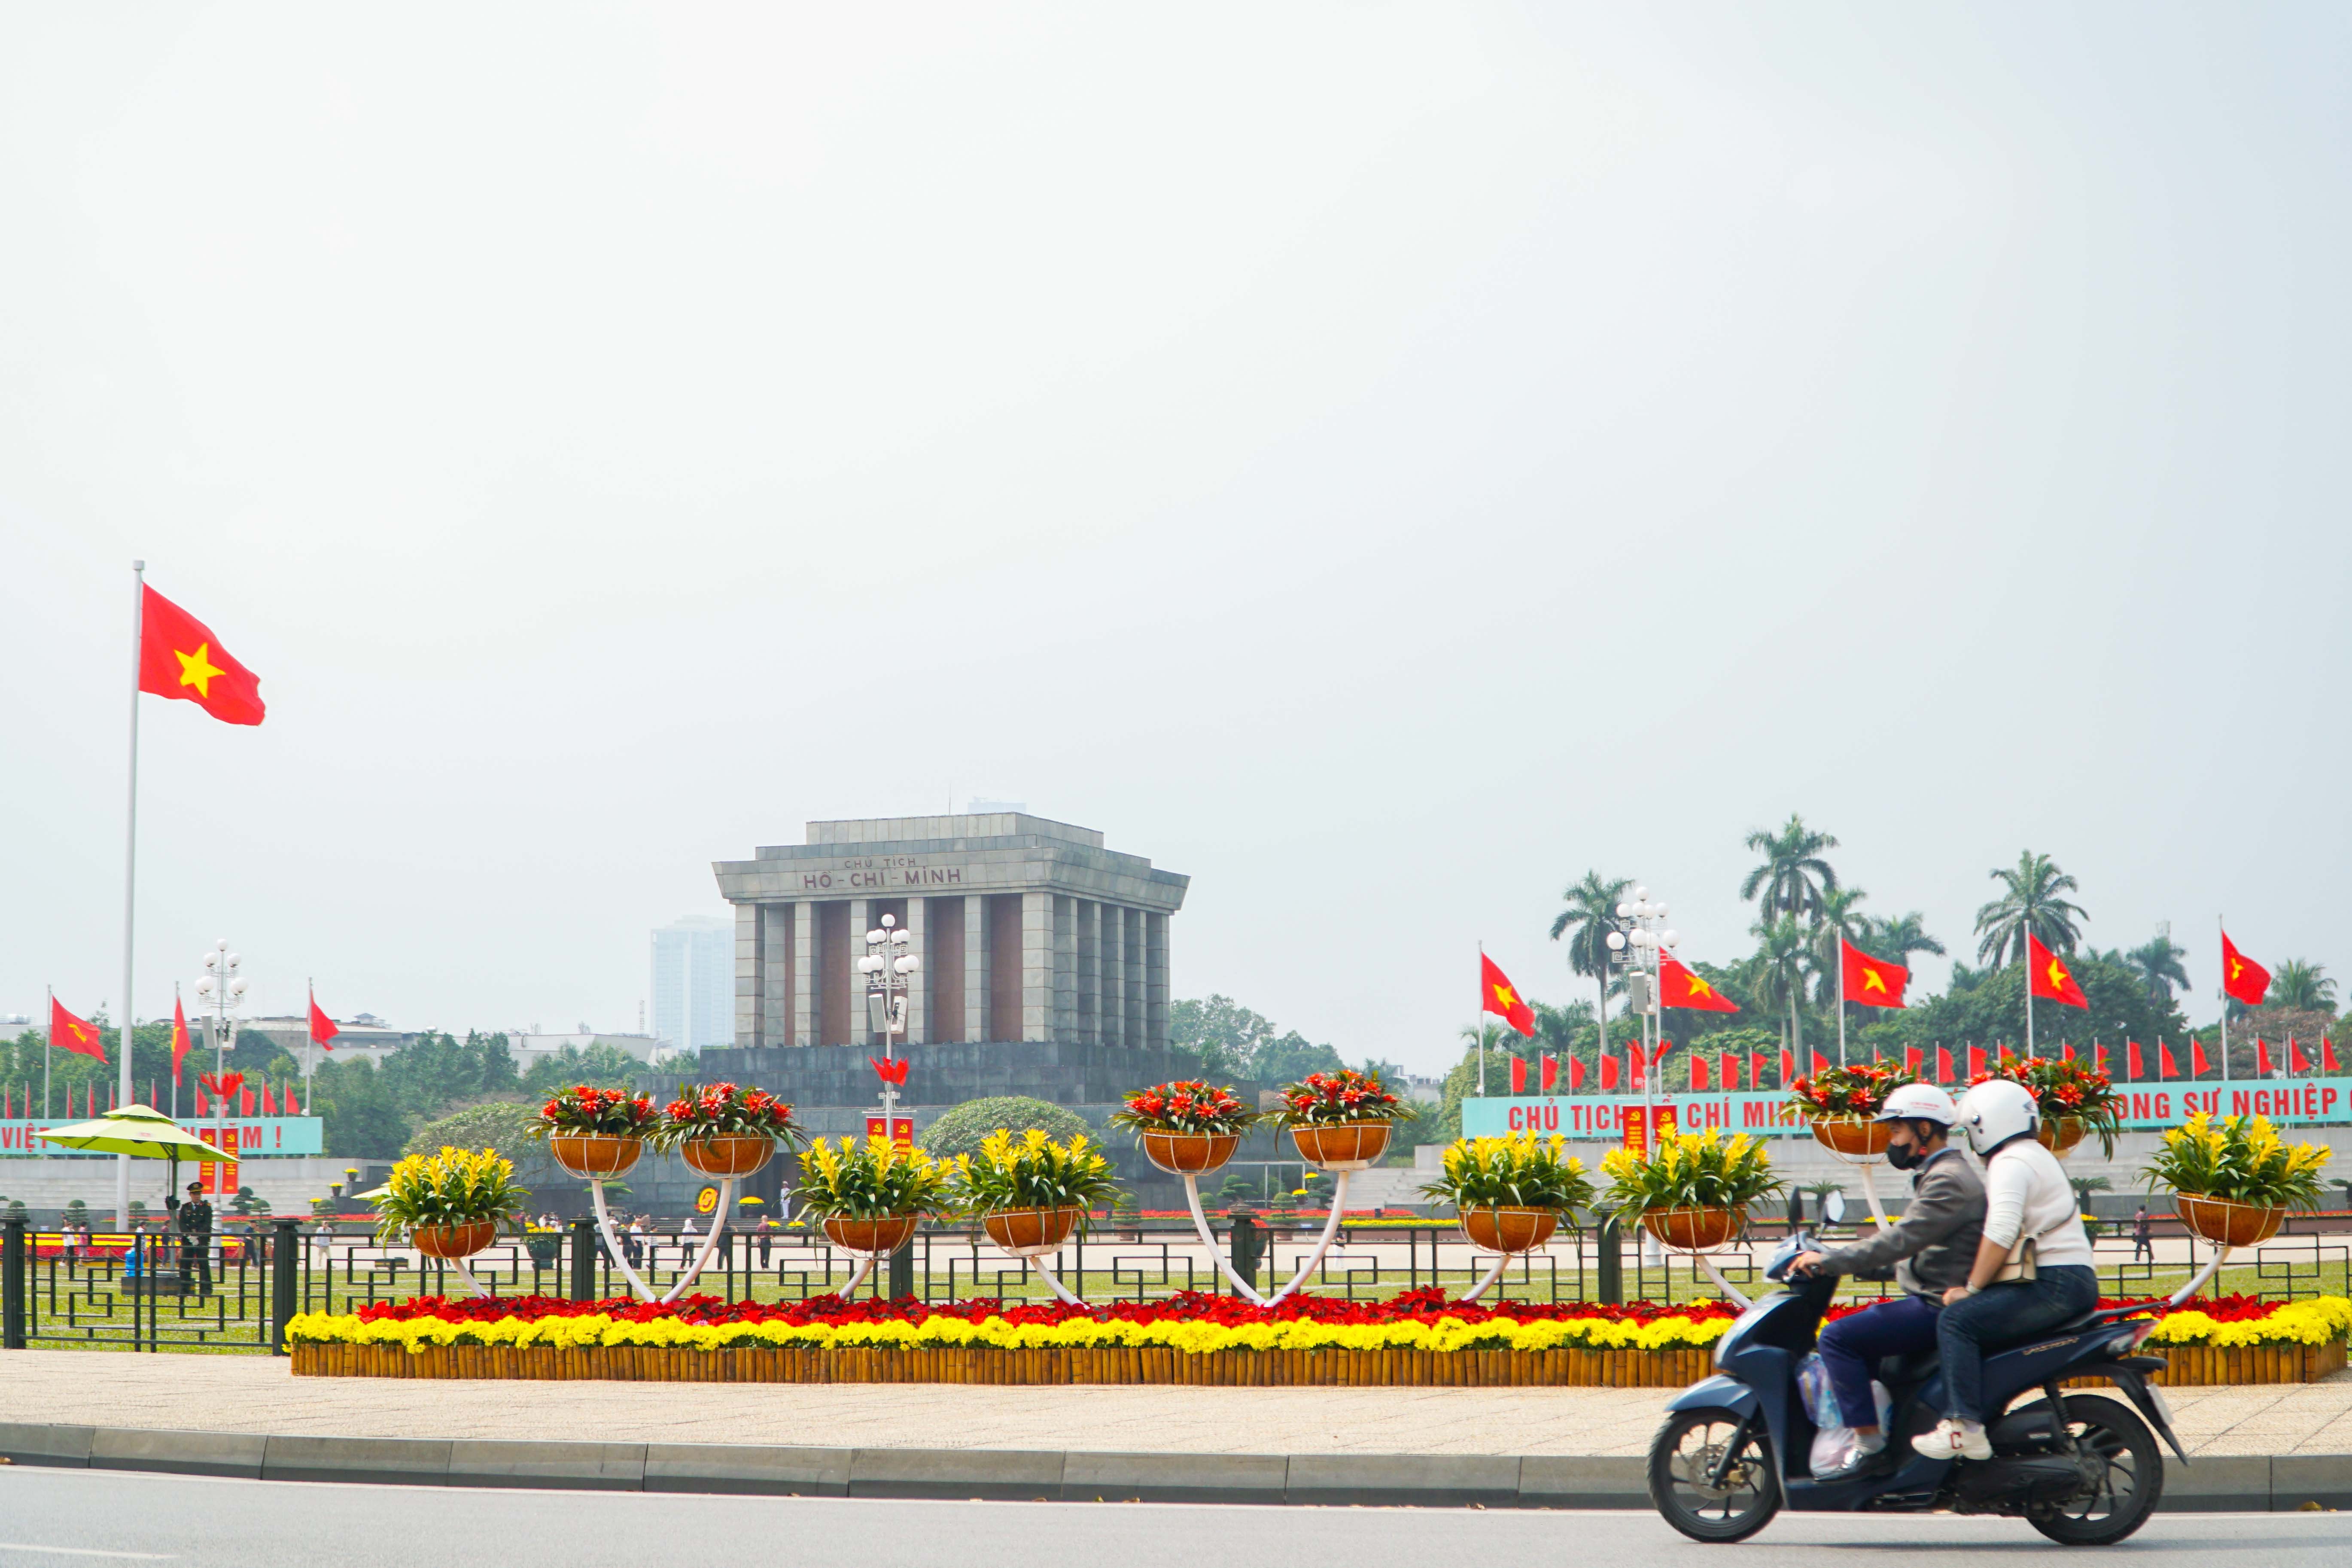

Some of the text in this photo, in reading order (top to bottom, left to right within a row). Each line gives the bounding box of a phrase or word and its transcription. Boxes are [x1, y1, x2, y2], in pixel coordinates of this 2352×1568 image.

[1509, 1098, 1559, 1131] CHỦ
[1687, 1096, 1730, 1128] CHÍ
[2101, 1092, 2171, 1120] ONG
[2183, 1087, 2222, 1123] SỰ
[2233, 1083, 2337, 1120] NGHIỆP
[1, 1122, 50, 1153] VIỆT
[1950, 1431, 1963, 1449] C
